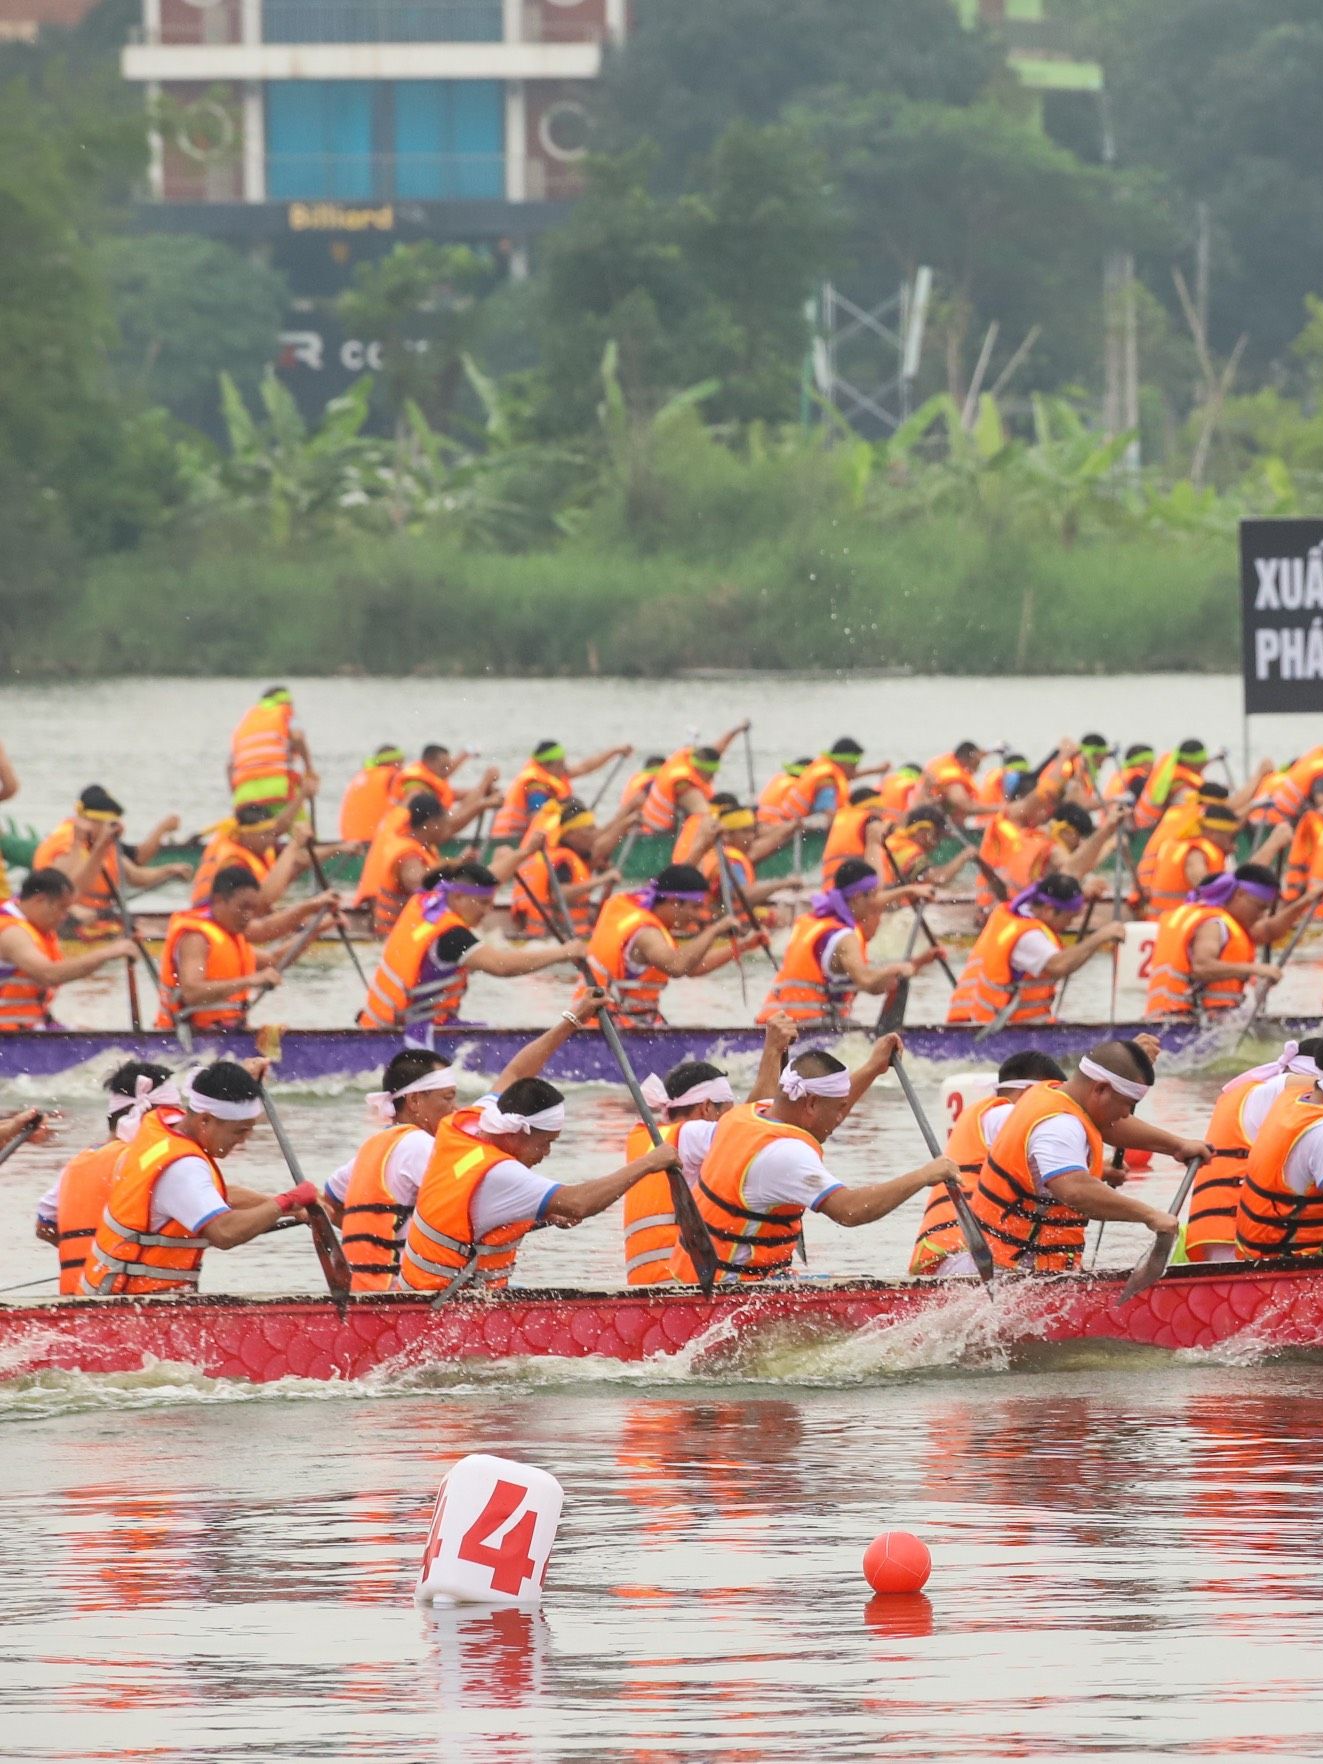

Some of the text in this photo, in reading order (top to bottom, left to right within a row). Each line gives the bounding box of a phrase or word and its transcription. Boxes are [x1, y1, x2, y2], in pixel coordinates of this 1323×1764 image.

[288, 203, 393, 231] Billiard
[1139, 940, 1154, 977] 2
[457, 1479, 538, 1596] 4
